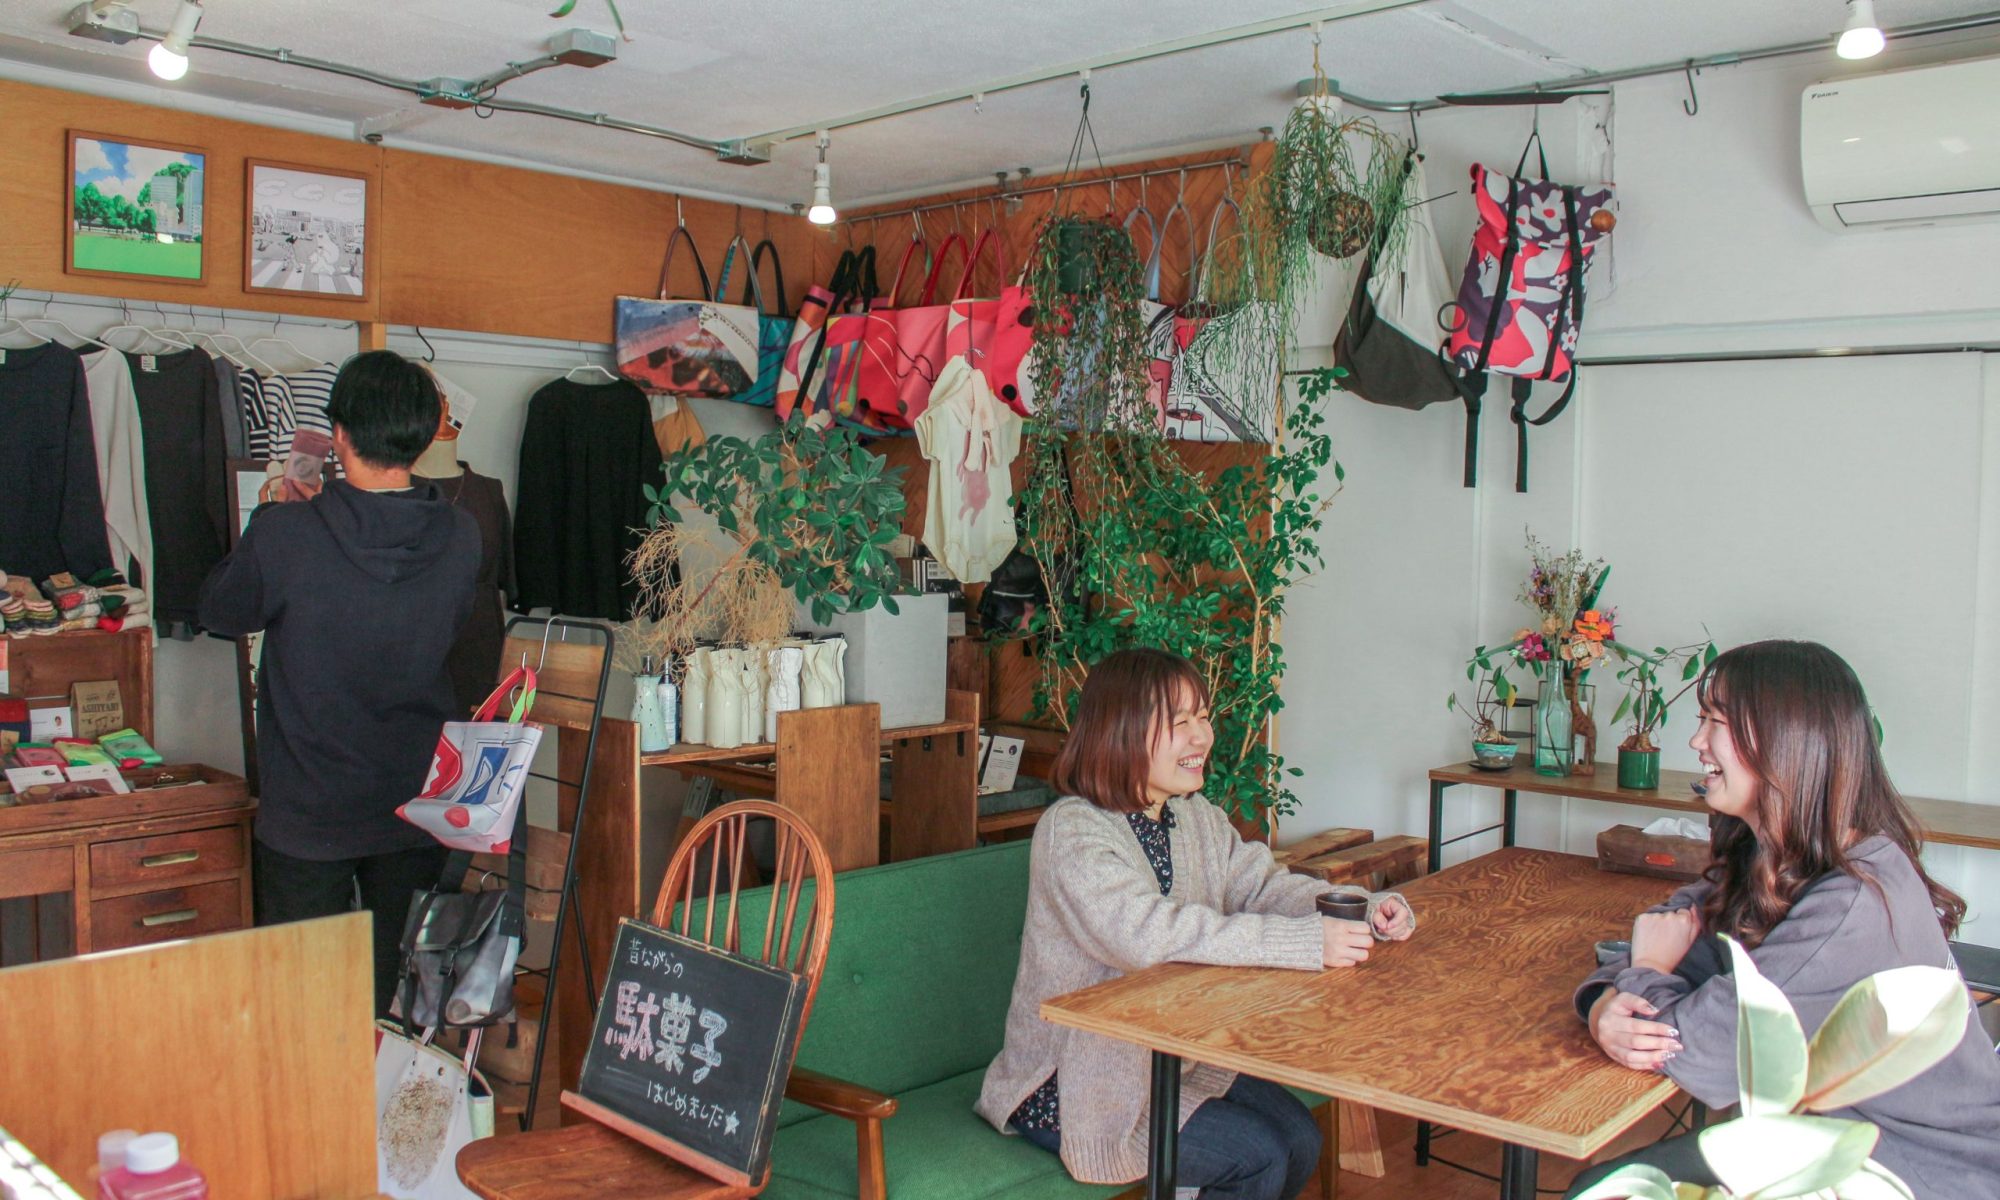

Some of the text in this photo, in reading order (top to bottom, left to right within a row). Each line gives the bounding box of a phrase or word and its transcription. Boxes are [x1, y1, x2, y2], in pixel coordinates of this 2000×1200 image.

[628, 937, 684, 978] 昔ながらの
[604, 980, 727, 1085] 駄菓子
